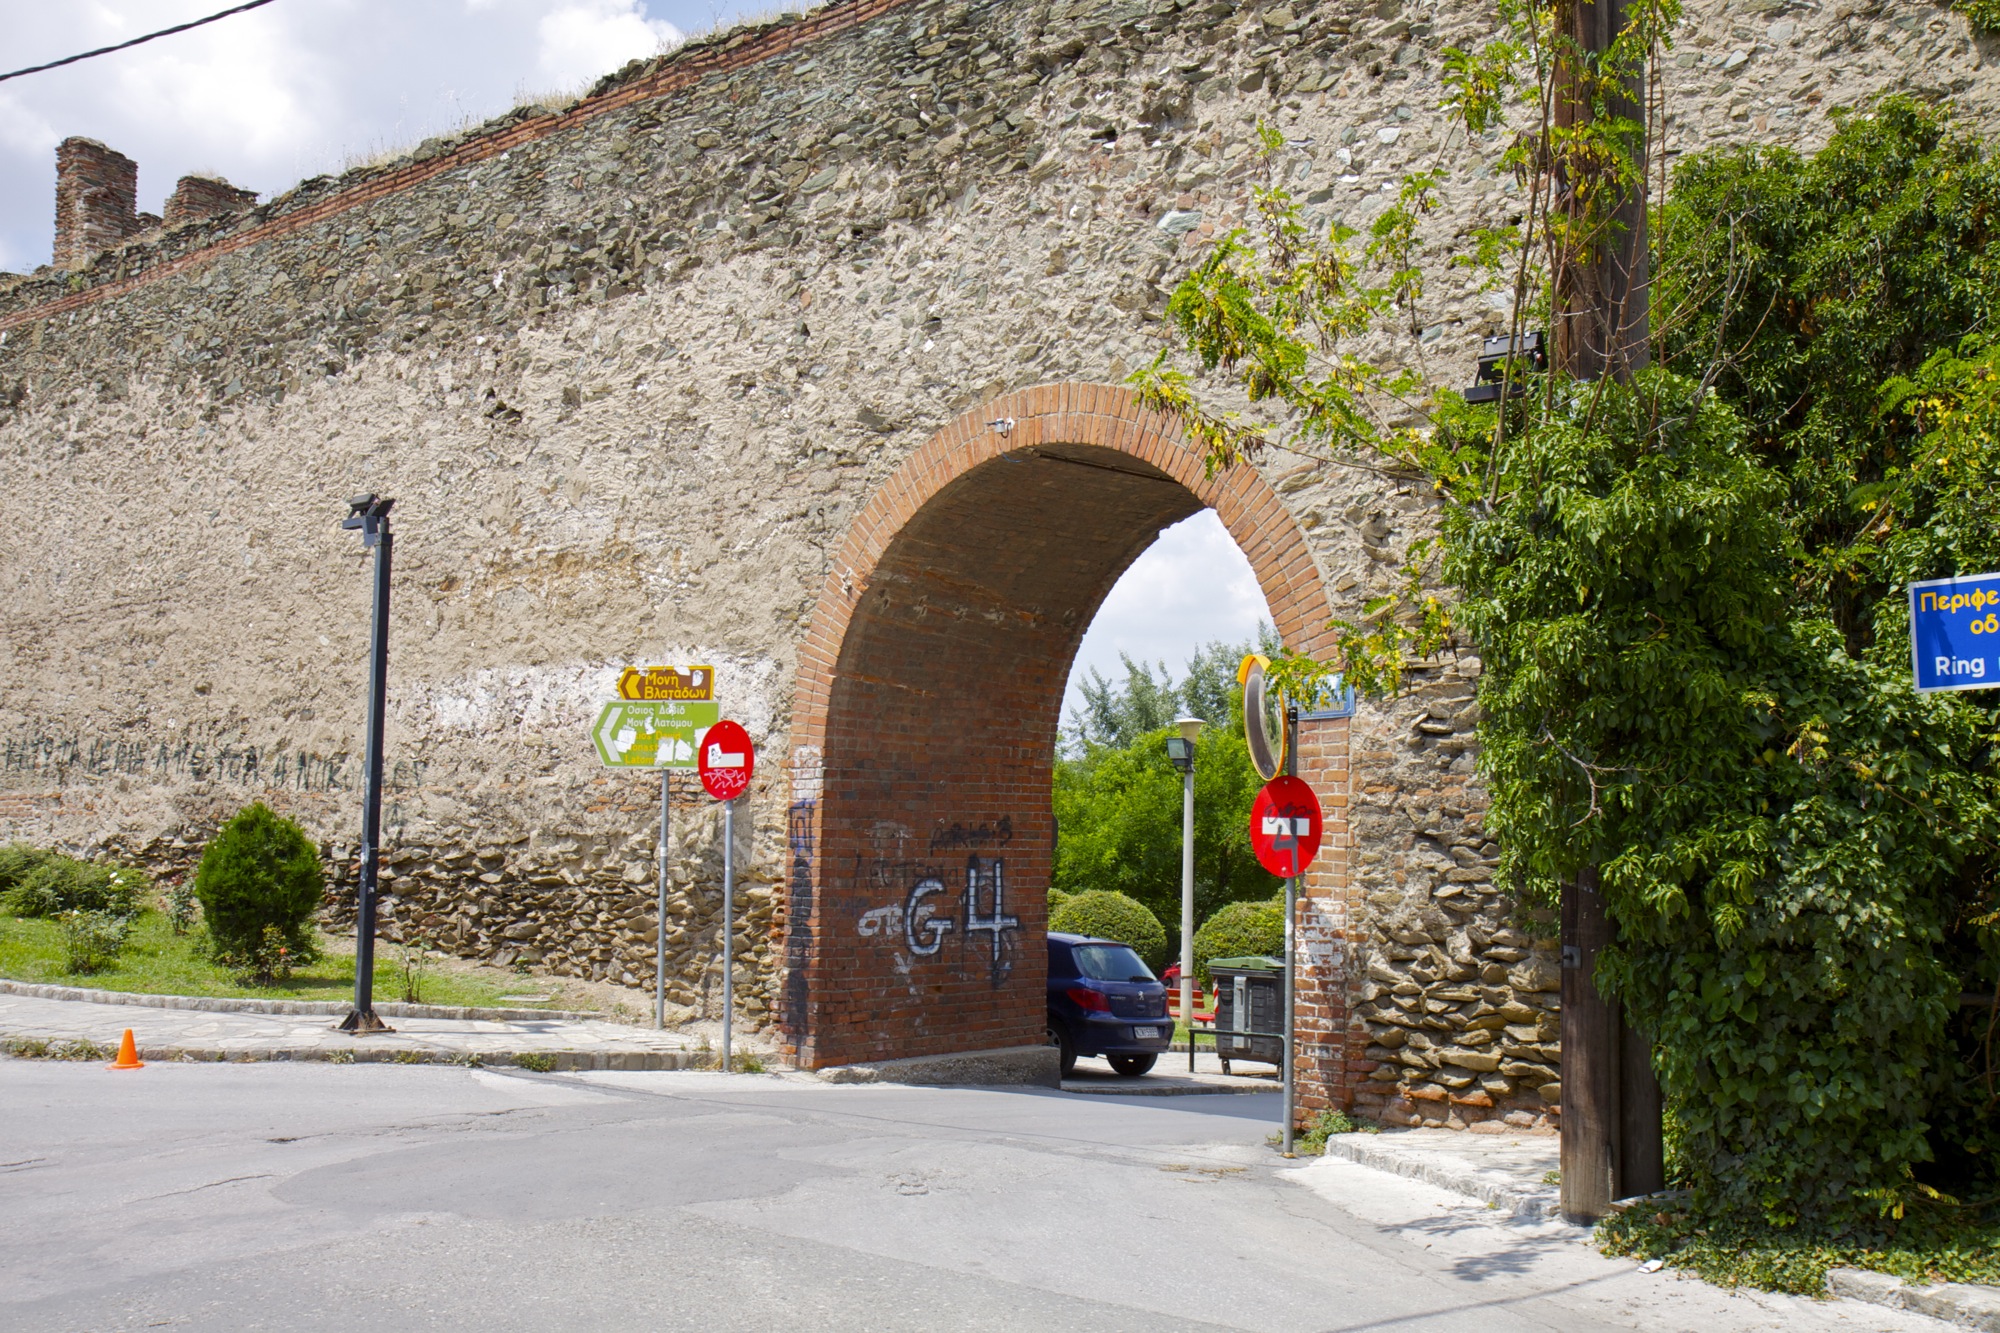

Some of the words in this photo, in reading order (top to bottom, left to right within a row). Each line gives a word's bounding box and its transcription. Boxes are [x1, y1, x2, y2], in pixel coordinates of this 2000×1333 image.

[1921, 588, 2000, 614] Περιφε
[1970, 613, 2000, 635] οδ
[1935, 656, 1985, 678] Ring
[645, 671, 679, 688] Μονή
[644, 686, 706, 699] Βλατάδων
[626, 717, 651, 728] Μον
[654, 717, 692, 729] Λατόμου
[625, 755, 654, 764] Latom
